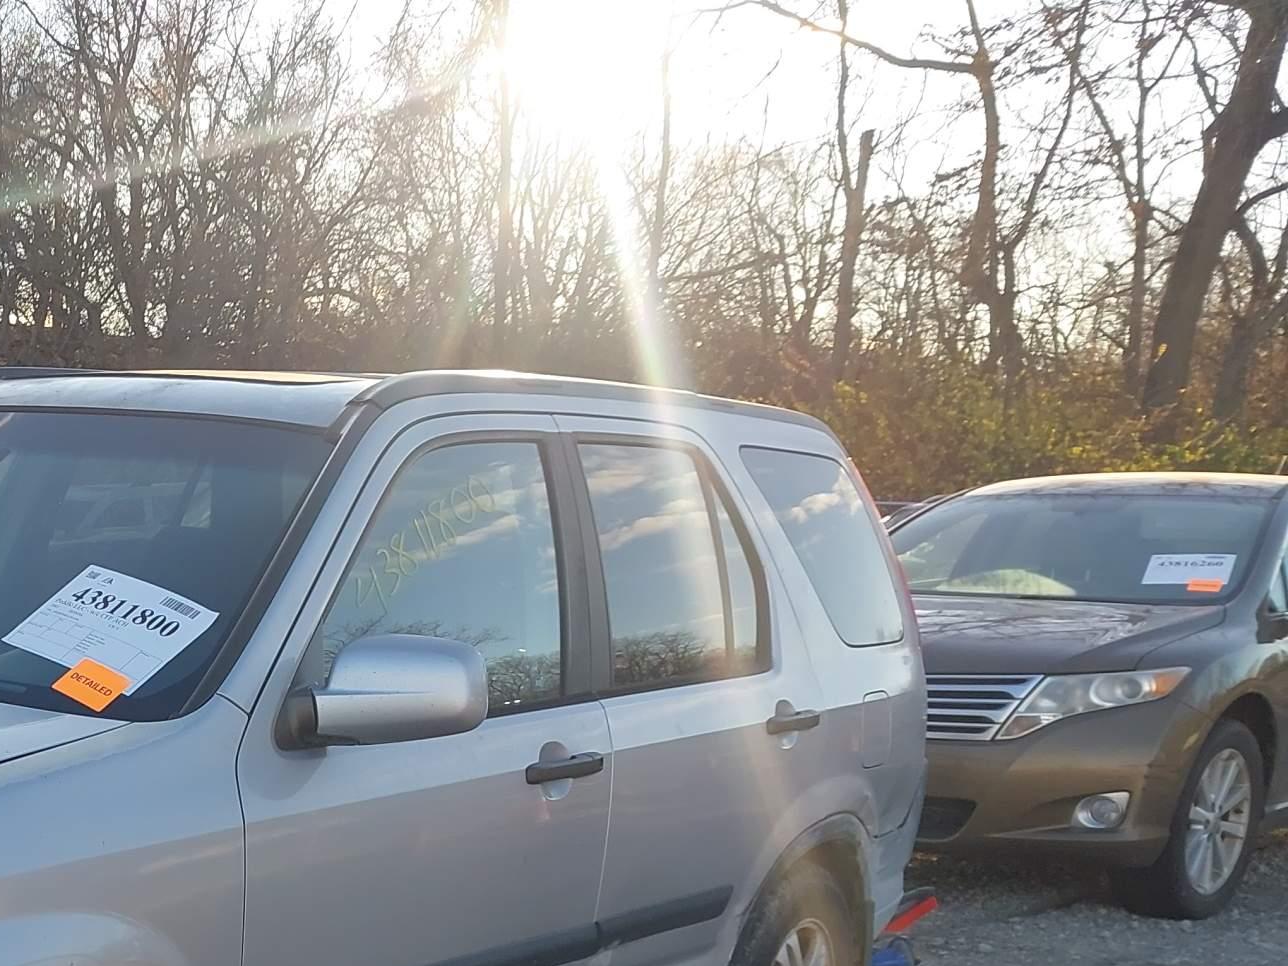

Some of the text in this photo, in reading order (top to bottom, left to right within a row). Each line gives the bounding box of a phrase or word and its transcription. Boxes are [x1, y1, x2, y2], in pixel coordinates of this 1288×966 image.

[354, 475, 494, 615] 43811800
[71, 587, 181, 638] 43811800
[70, 671, 113, 697] DETAILED
